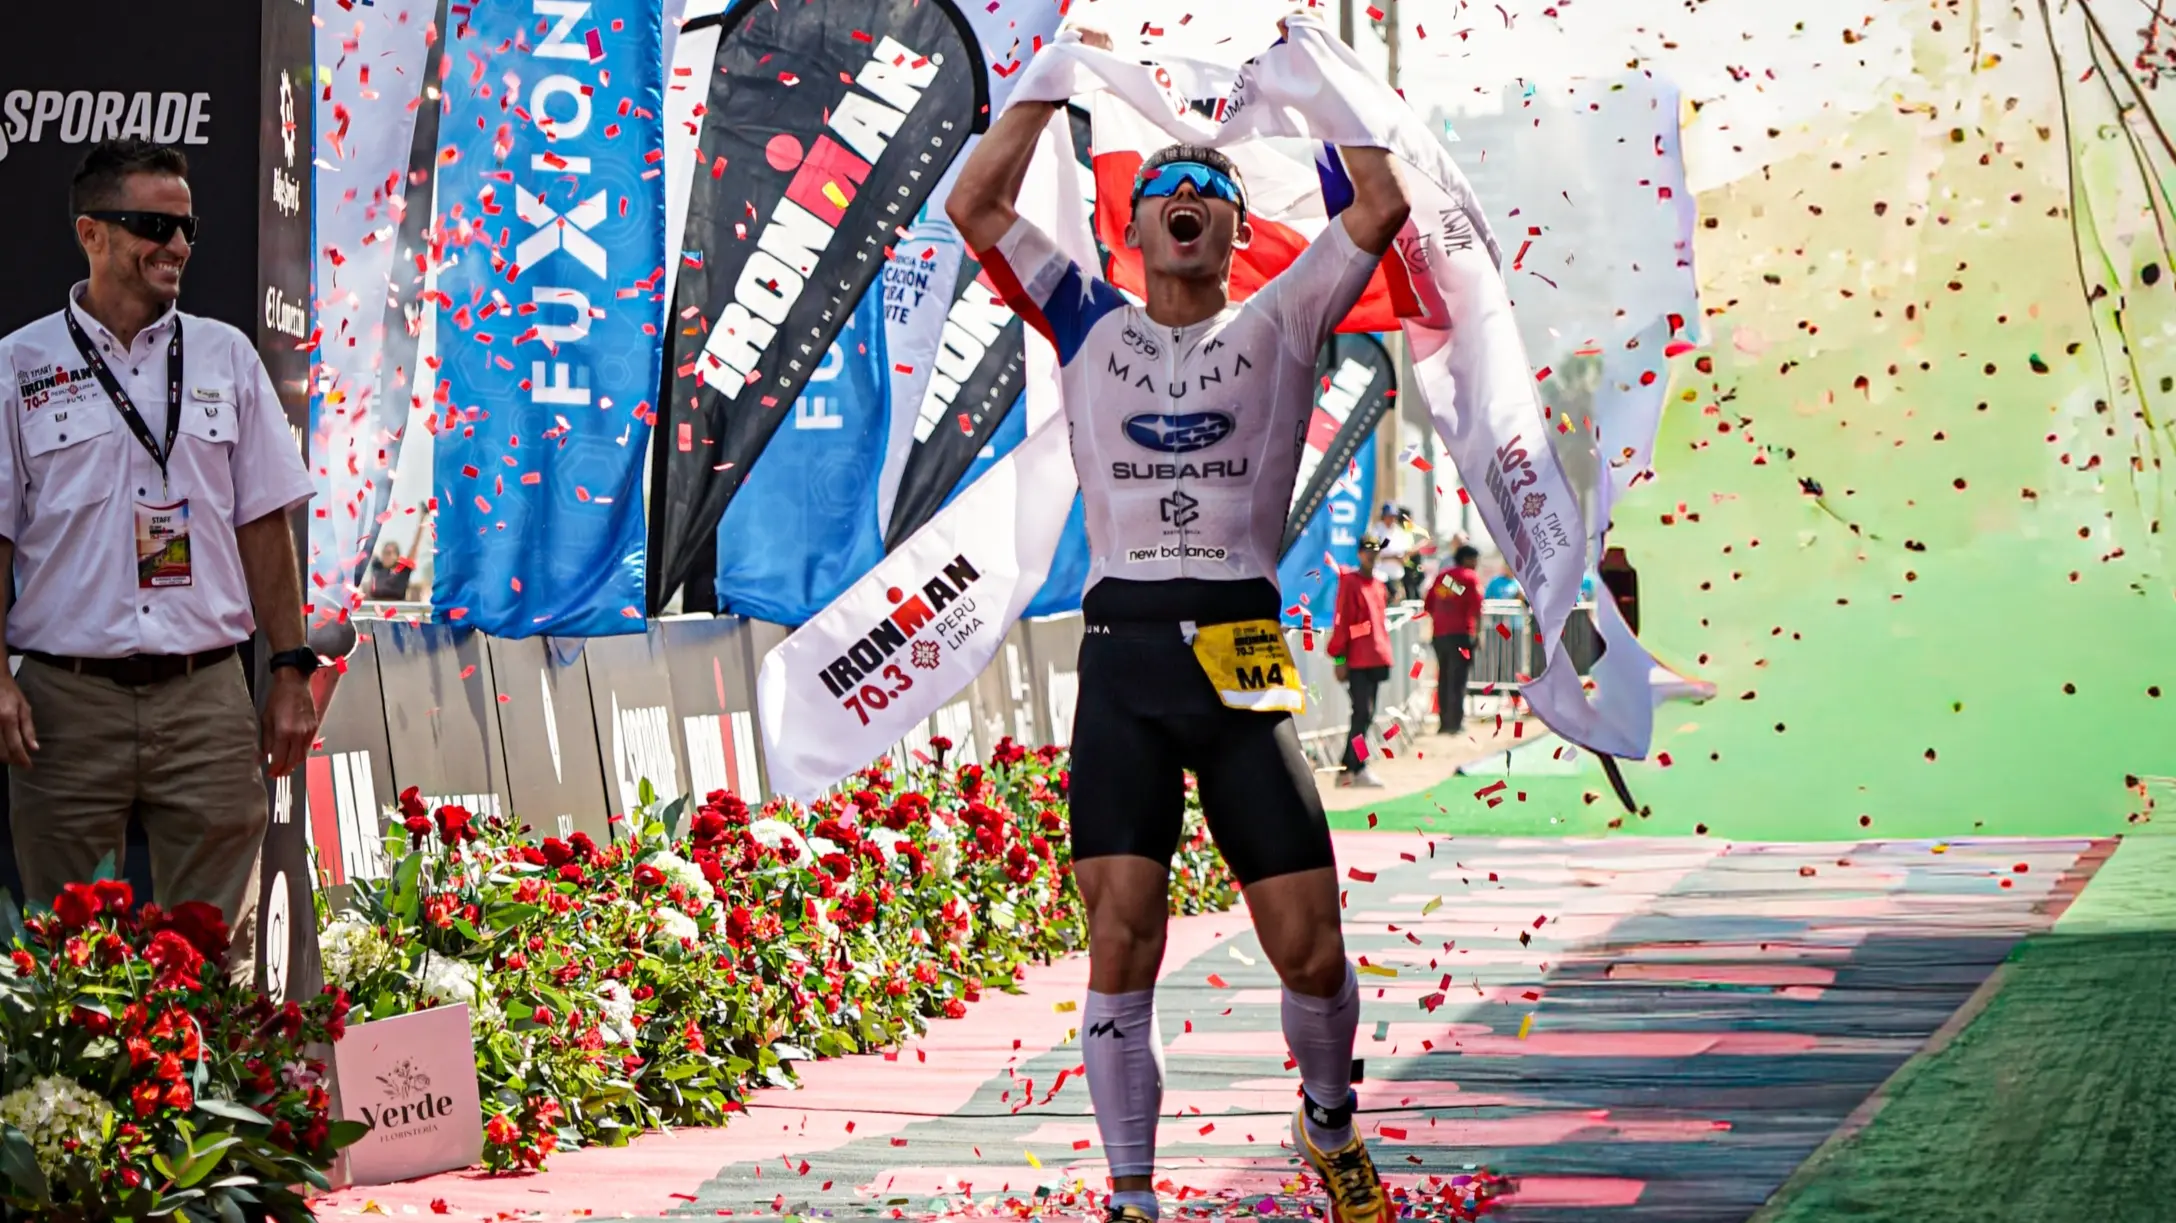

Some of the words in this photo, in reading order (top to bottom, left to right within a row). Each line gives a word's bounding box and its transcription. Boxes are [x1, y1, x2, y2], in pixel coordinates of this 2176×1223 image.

[4, 90, 211, 144] SPORADE
[515, 0, 608, 404] FUXION
[693, 35, 939, 400] IRONMAN
[779, 279, 851, 388] GRAPHIC
[857, 119, 954, 262] STANDARDS
[20, 366, 94, 398] IRONMAN
[1107, 351, 1252, 399] MAUNA
[24, 390, 50, 411] 70.3
[1112, 458, 1248, 479] SUBARU
[151, 516, 172, 525] STAFF
[1327, 462, 1392, 546] FUX
[1129, 550, 1158, 561] new
[1161, 545, 1226, 559] balance
[818, 553, 981, 699] IRONMAN
[935, 596, 976, 637] PERÚ
[947, 617, 985, 651] LIMA
[1085, 625, 1111, 635] UNA
[843, 664, 914, 727] 70.3
[1236, 663, 1285, 690] M4
[360, 1092, 454, 1131] Verde
